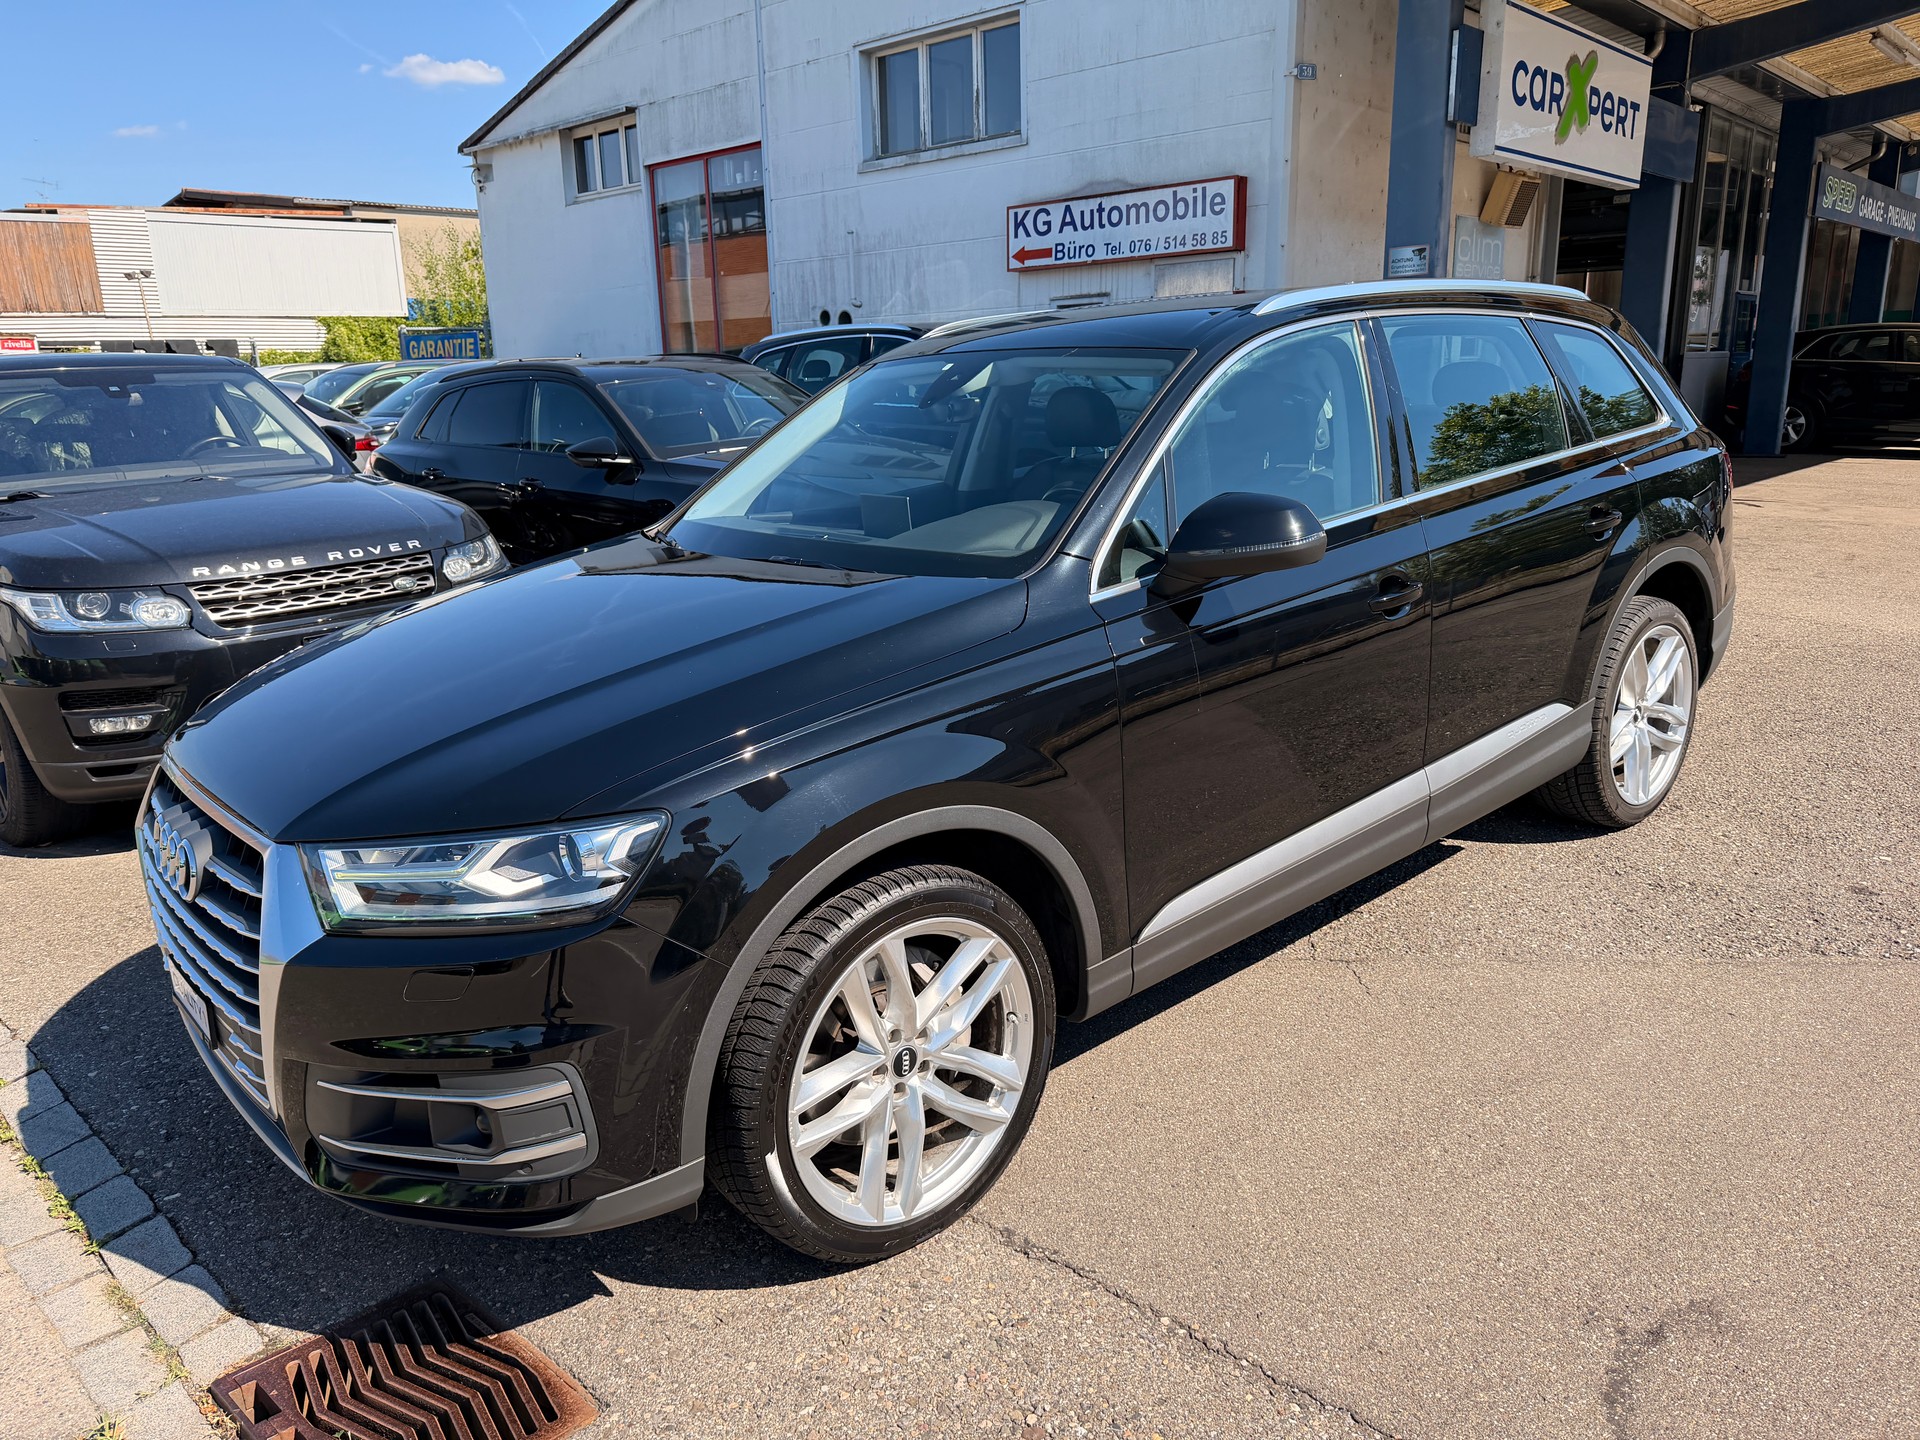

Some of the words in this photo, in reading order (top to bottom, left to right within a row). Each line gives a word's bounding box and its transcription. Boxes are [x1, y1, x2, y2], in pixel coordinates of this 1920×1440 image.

[1013, 207, 1052, 239] KG
[1058, 186, 1227, 234] Automobile
[1822, 175, 1857, 214] SPEED
[1858, 195, 1884, 223] GARAGE
[1886, 205, 1917, 232] PNEUHAUS
[1054, 241, 1096, 262] Büro
[1103, 242, 1125, 257] Tel.
[1129, 238, 1152, 254] 076
[1163, 234, 1187, 251] 514
[1191, 232, 1207, 248] 58
[1211, 230, 1228, 246] 85
[1457, 228, 1502, 264] clim
[1455, 263, 1501, 279] service
[3, 340, 32, 348] rivella
[409, 337, 475, 359] GARANTIE
[192, 555, 307, 577] RANGE
[327, 539, 422, 561] ROVER
